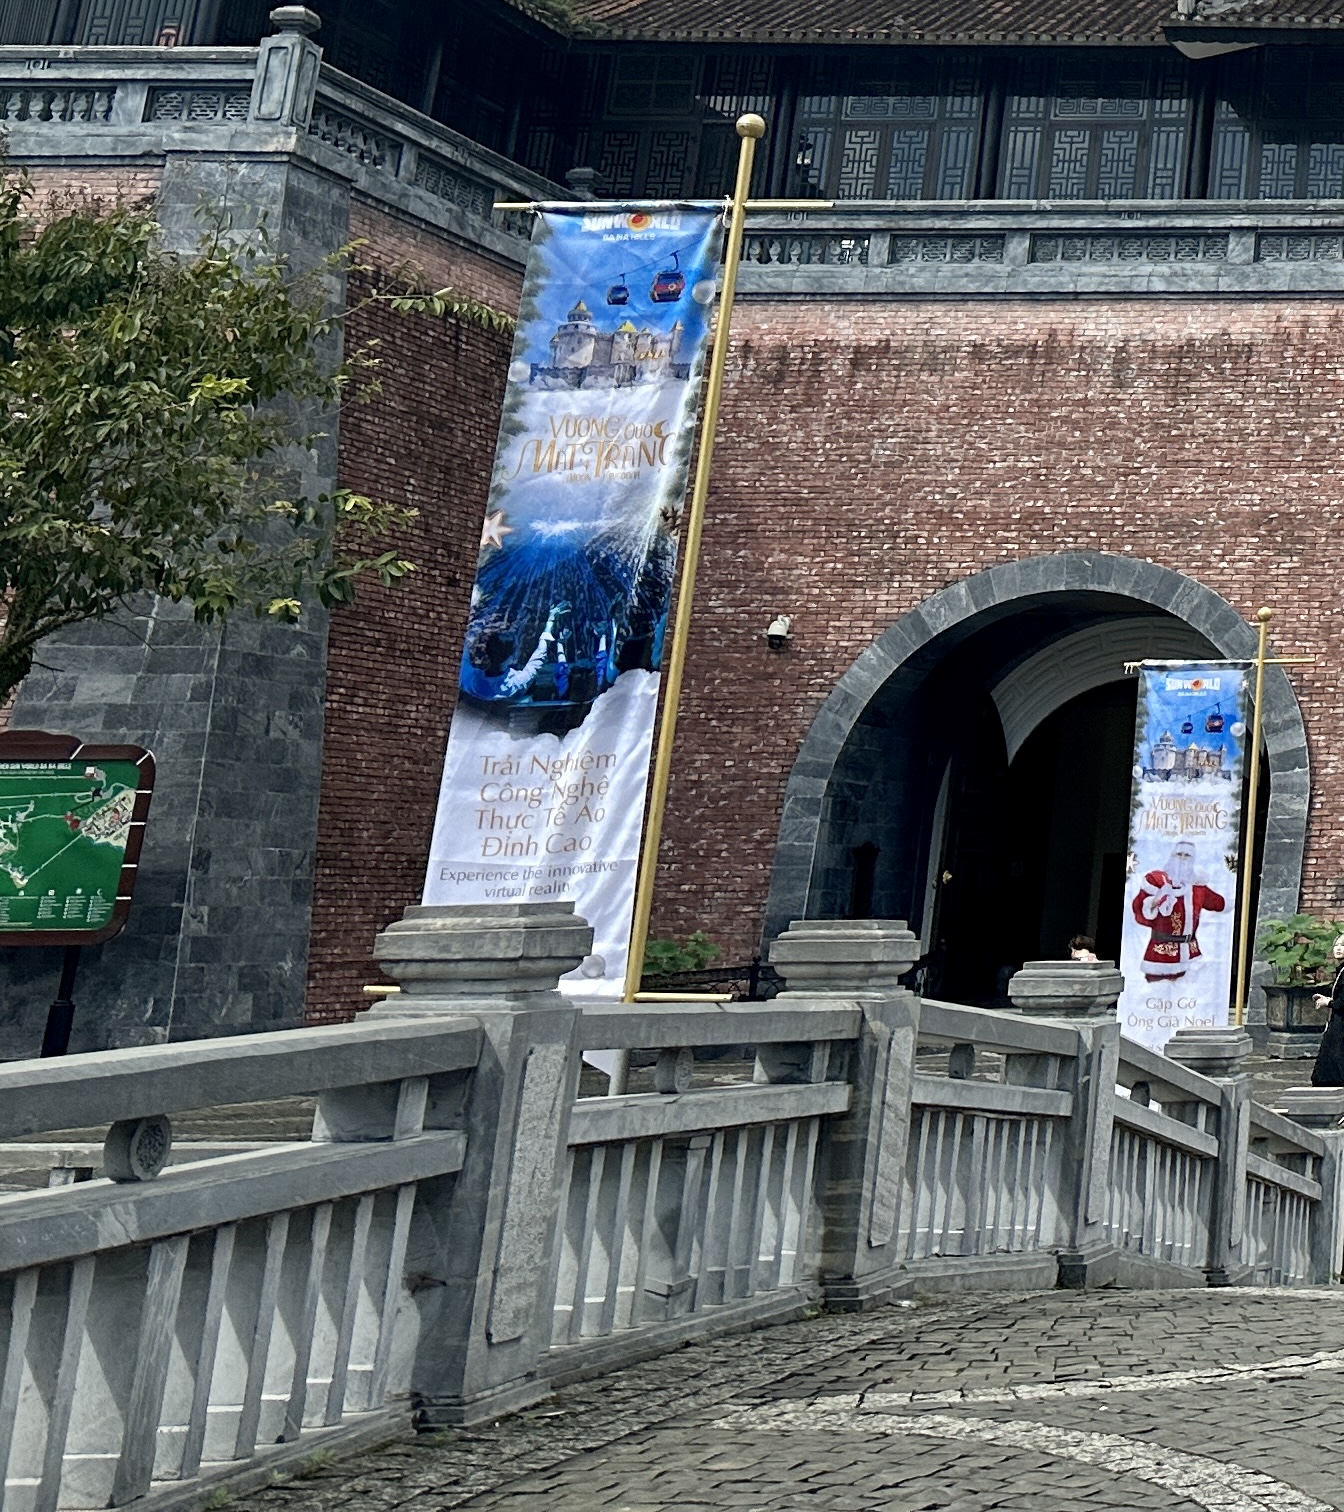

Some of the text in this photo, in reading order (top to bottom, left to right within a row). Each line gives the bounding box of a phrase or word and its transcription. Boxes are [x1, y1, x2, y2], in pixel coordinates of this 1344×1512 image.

[480, 750, 617, 781] Trải Nghiệm
[480, 776, 610, 809] Công Nghệ
[475, 809, 534, 834] Thực
[574, 797, 605, 824] Ảo
[481, 833, 592, 857] Đỉnh Cao
[440, 859, 619, 885] Experience the innovative
[485, 879, 573, 898] virtual reality
[1127, 1012, 1154, 1031] Ông
[1183, 1014, 1216, 1027] Noel
